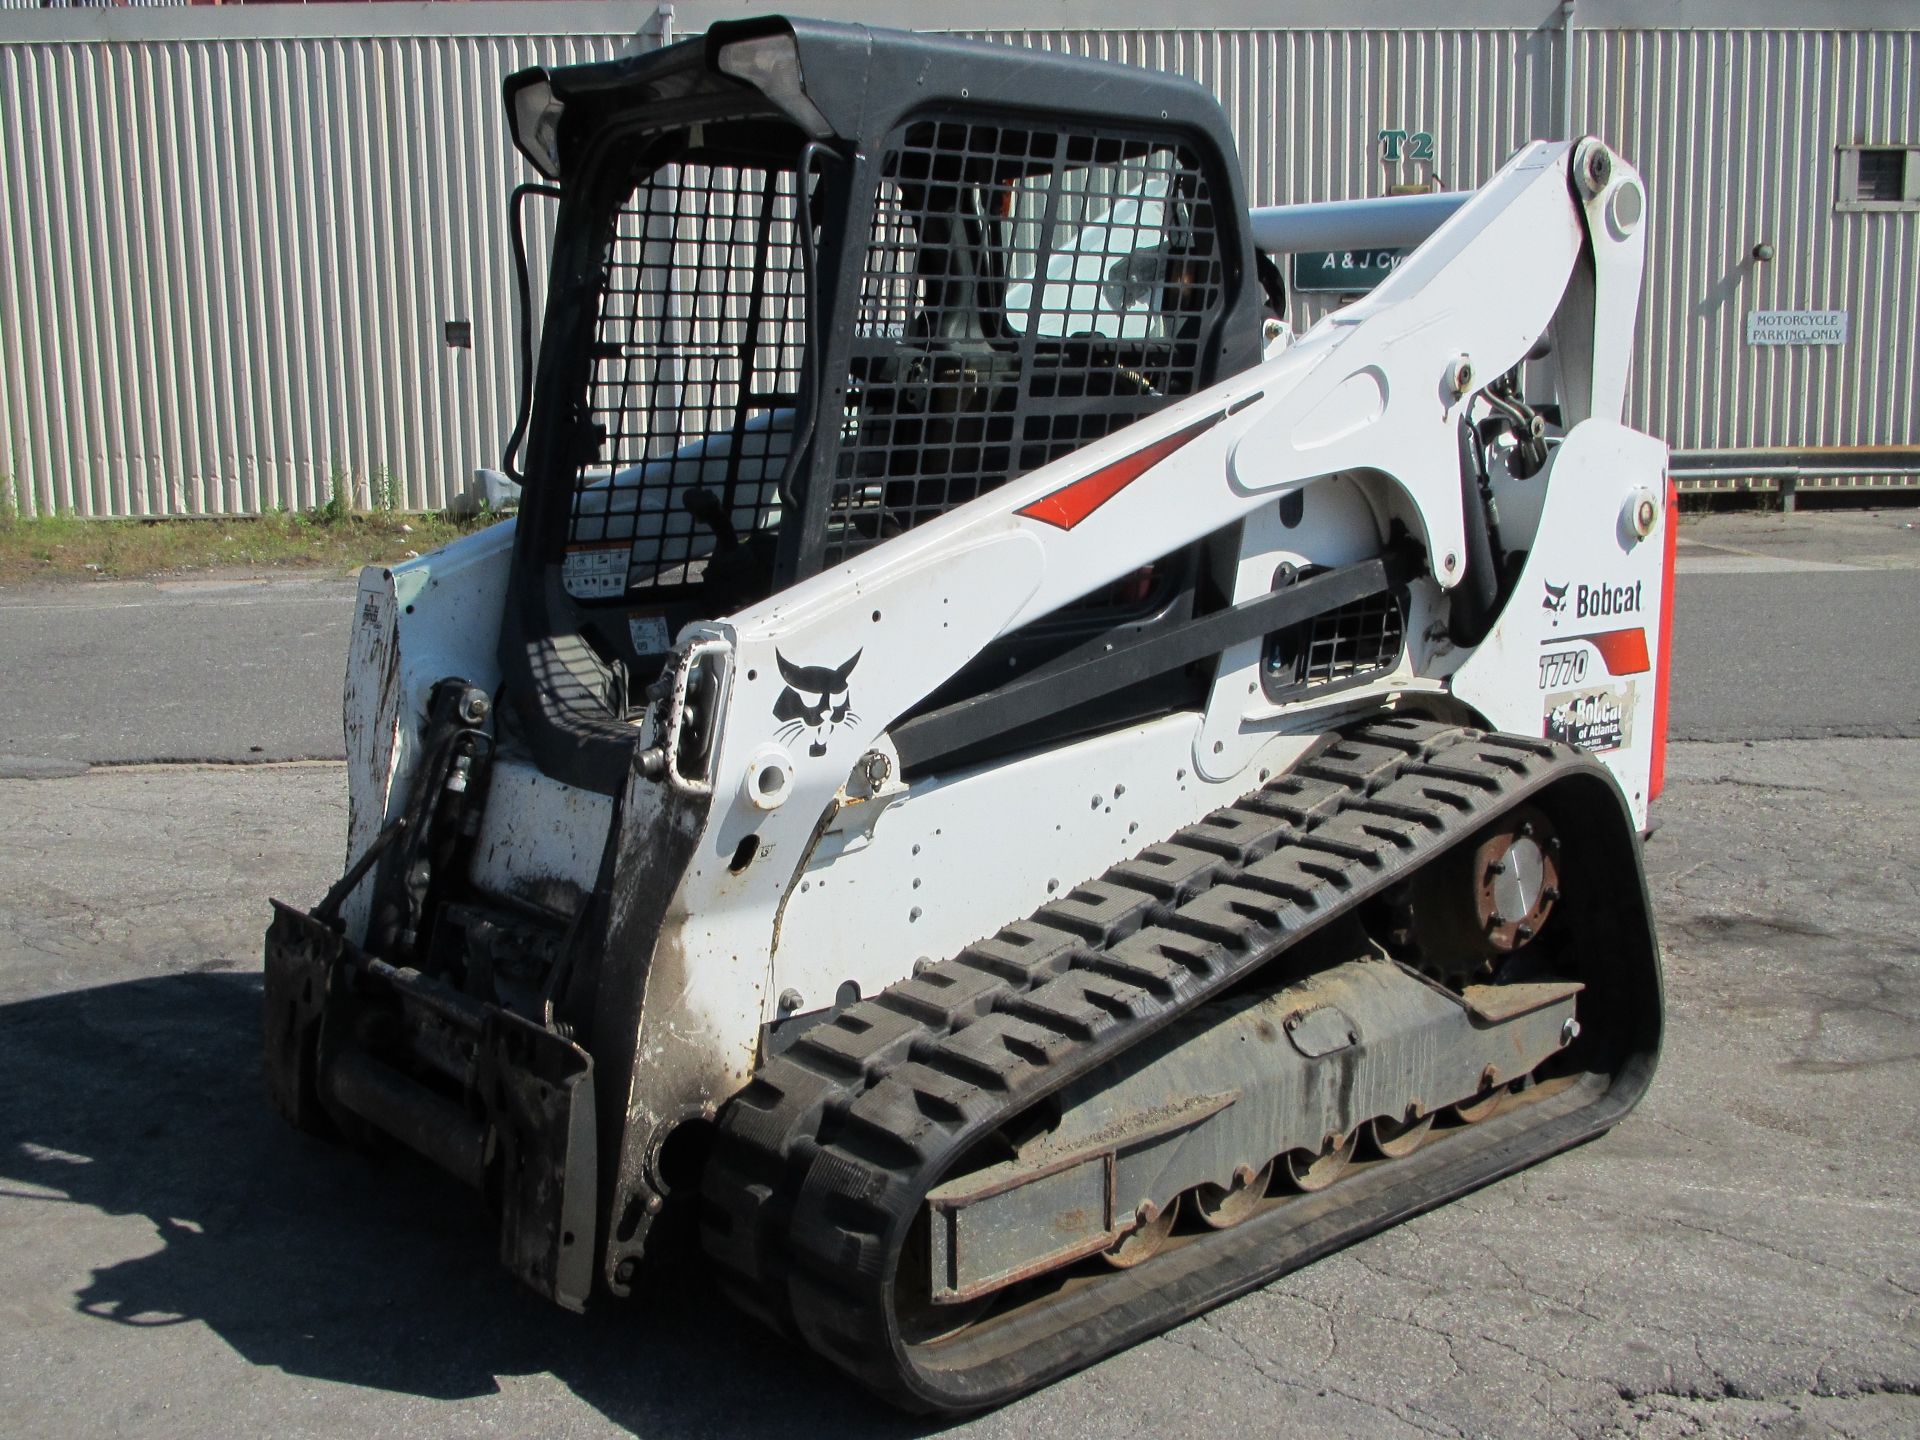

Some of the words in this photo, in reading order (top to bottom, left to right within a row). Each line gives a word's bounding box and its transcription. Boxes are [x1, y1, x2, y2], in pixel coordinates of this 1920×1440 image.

[1378, 129, 1434, 161] T2
[1322, 252, 1336, 269] A
[1341, 252, 1354, 269] &
[1360, 252, 1371, 269] J
[1757, 315, 1839, 326] MOTORCYCLE
[1753, 329, 1806, 340] PARKING
[1811, 329, 1842, 340] ONLY
[1577, 580, 1641, 618] Bobcat
[1539, 649, 1589, 689] T770
[1578, 726, 1588, 740] of
[1589, 722, 1618, 738] Atlanta
